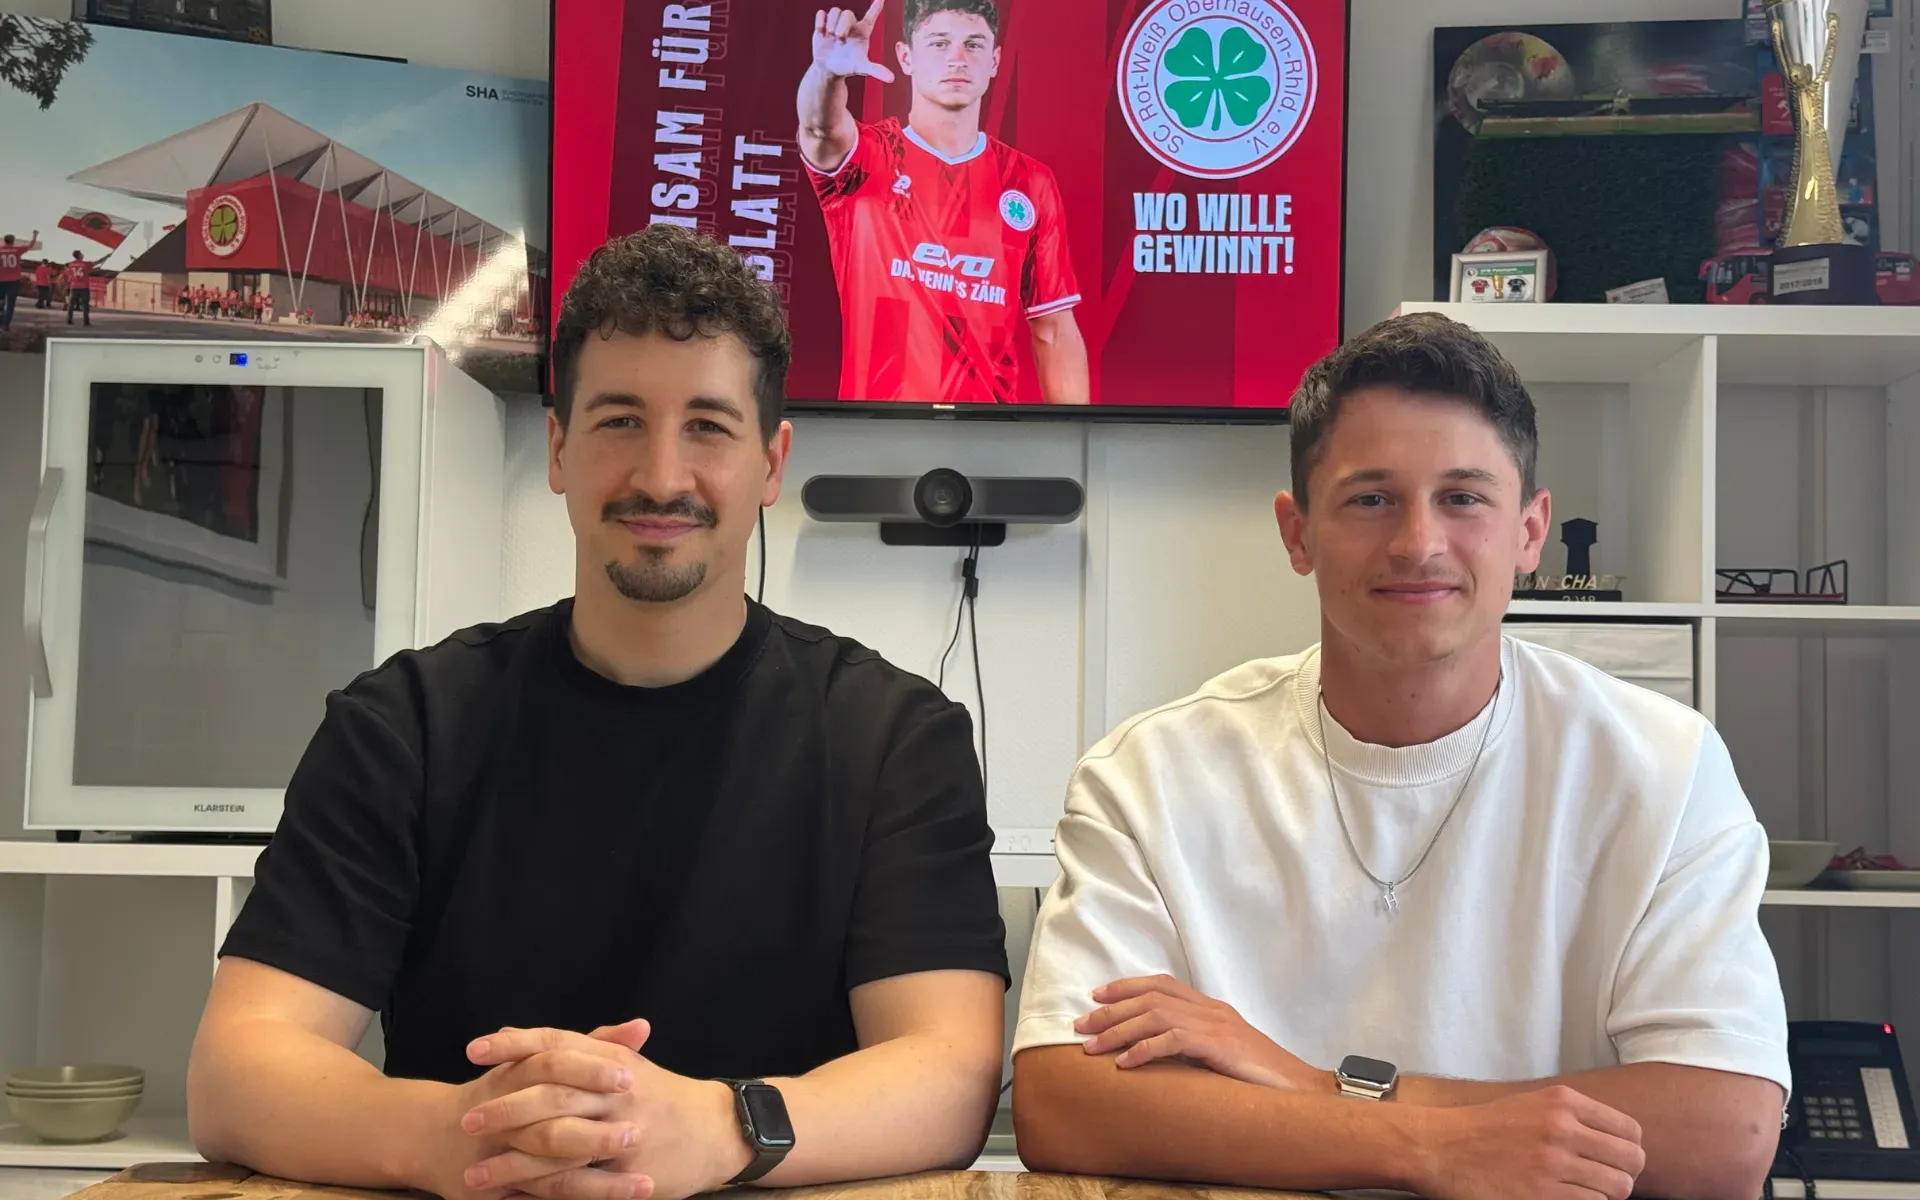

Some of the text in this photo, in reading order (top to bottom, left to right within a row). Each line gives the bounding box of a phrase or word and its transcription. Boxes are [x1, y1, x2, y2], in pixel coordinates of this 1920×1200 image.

[652, 4, 711, 91] FÜR
[1131, 21, 1167, 122] Rot-Weiß
[466, 85, 499, 101] SHA
[1152, 124, 1184, 154] SC
[1133, 192, 1292, 232] WO WILLE
[890, 258, 915, 281] DA,
[912, 242, 995, 278] evo
[1133, 234, 1294, 274] GEWINNT!
[194, 804, 245, 813] KLARSTEIN
